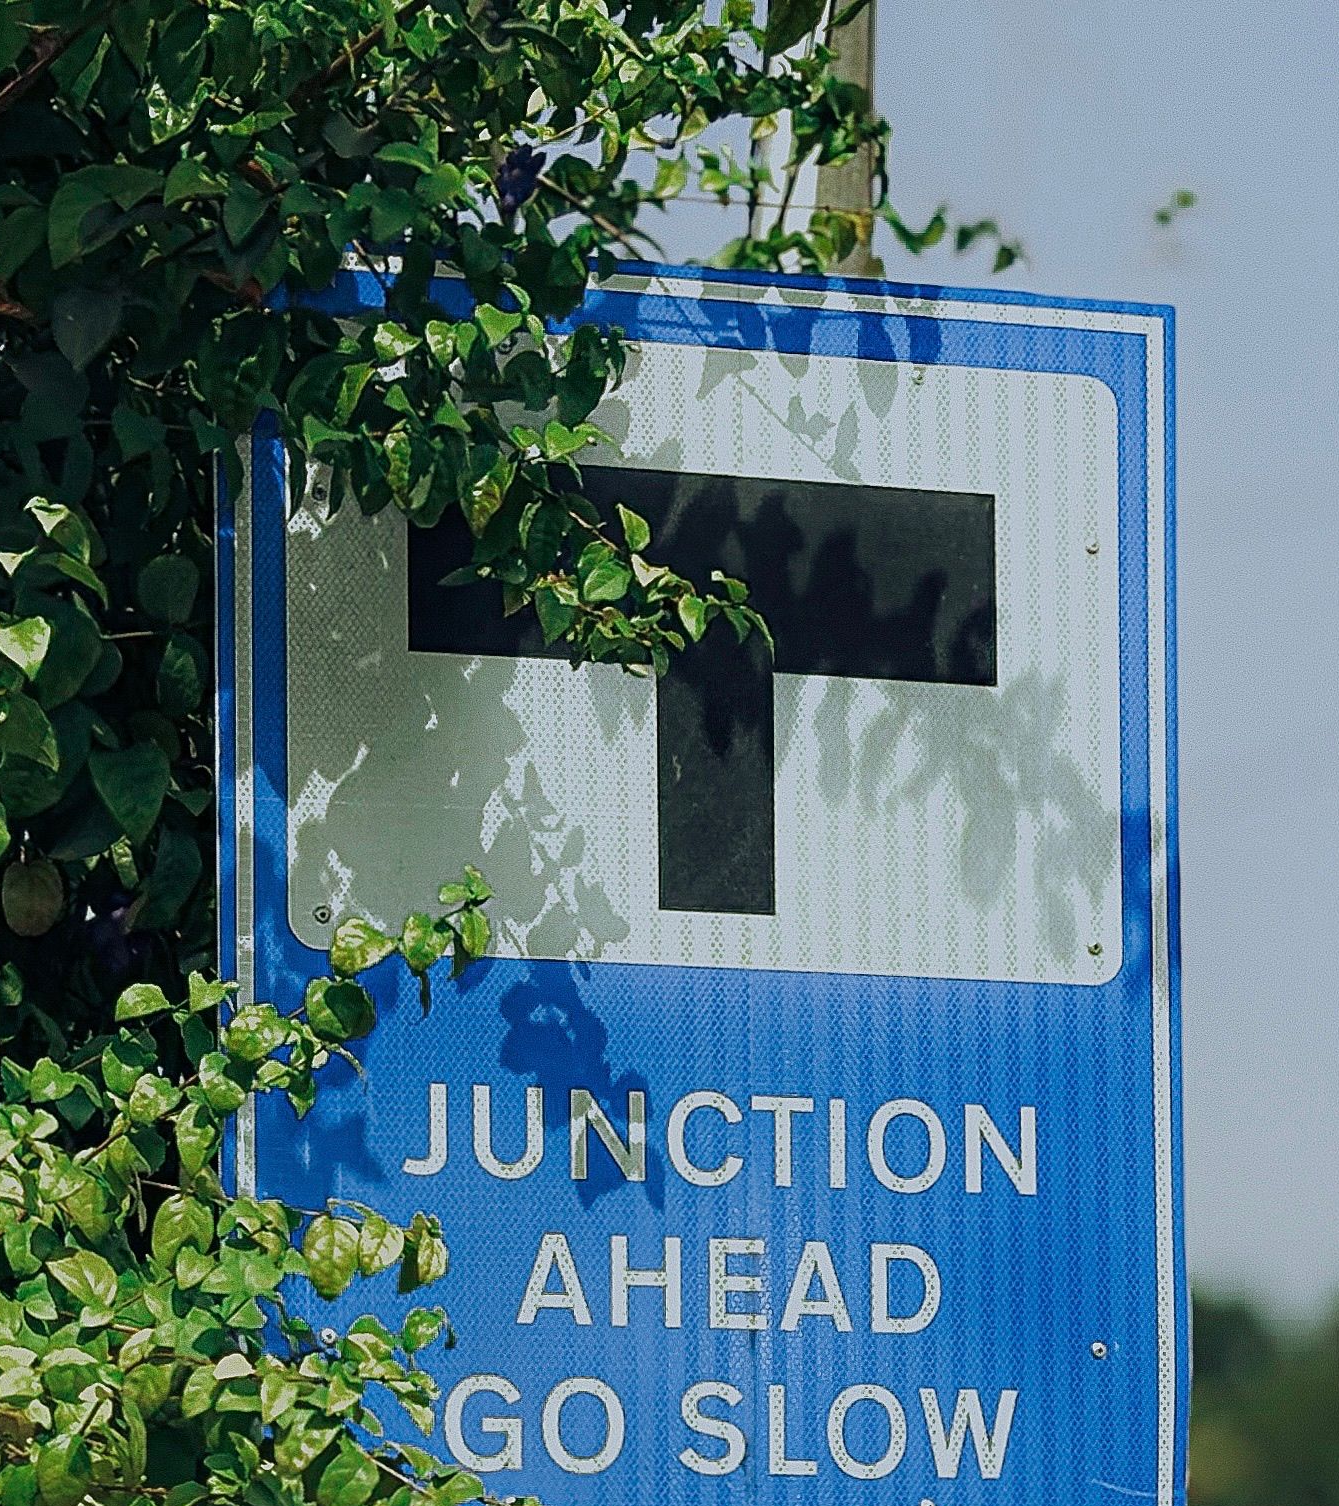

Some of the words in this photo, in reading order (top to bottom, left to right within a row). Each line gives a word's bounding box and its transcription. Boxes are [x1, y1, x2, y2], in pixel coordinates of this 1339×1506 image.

[402, 1082, 1037, 1196] JUNCTION
[516, 1230, 942, 1335] AHEAD
[444, 1373, 625, 1475] GO
[678, 1380, 1019, 1480] SLOW
